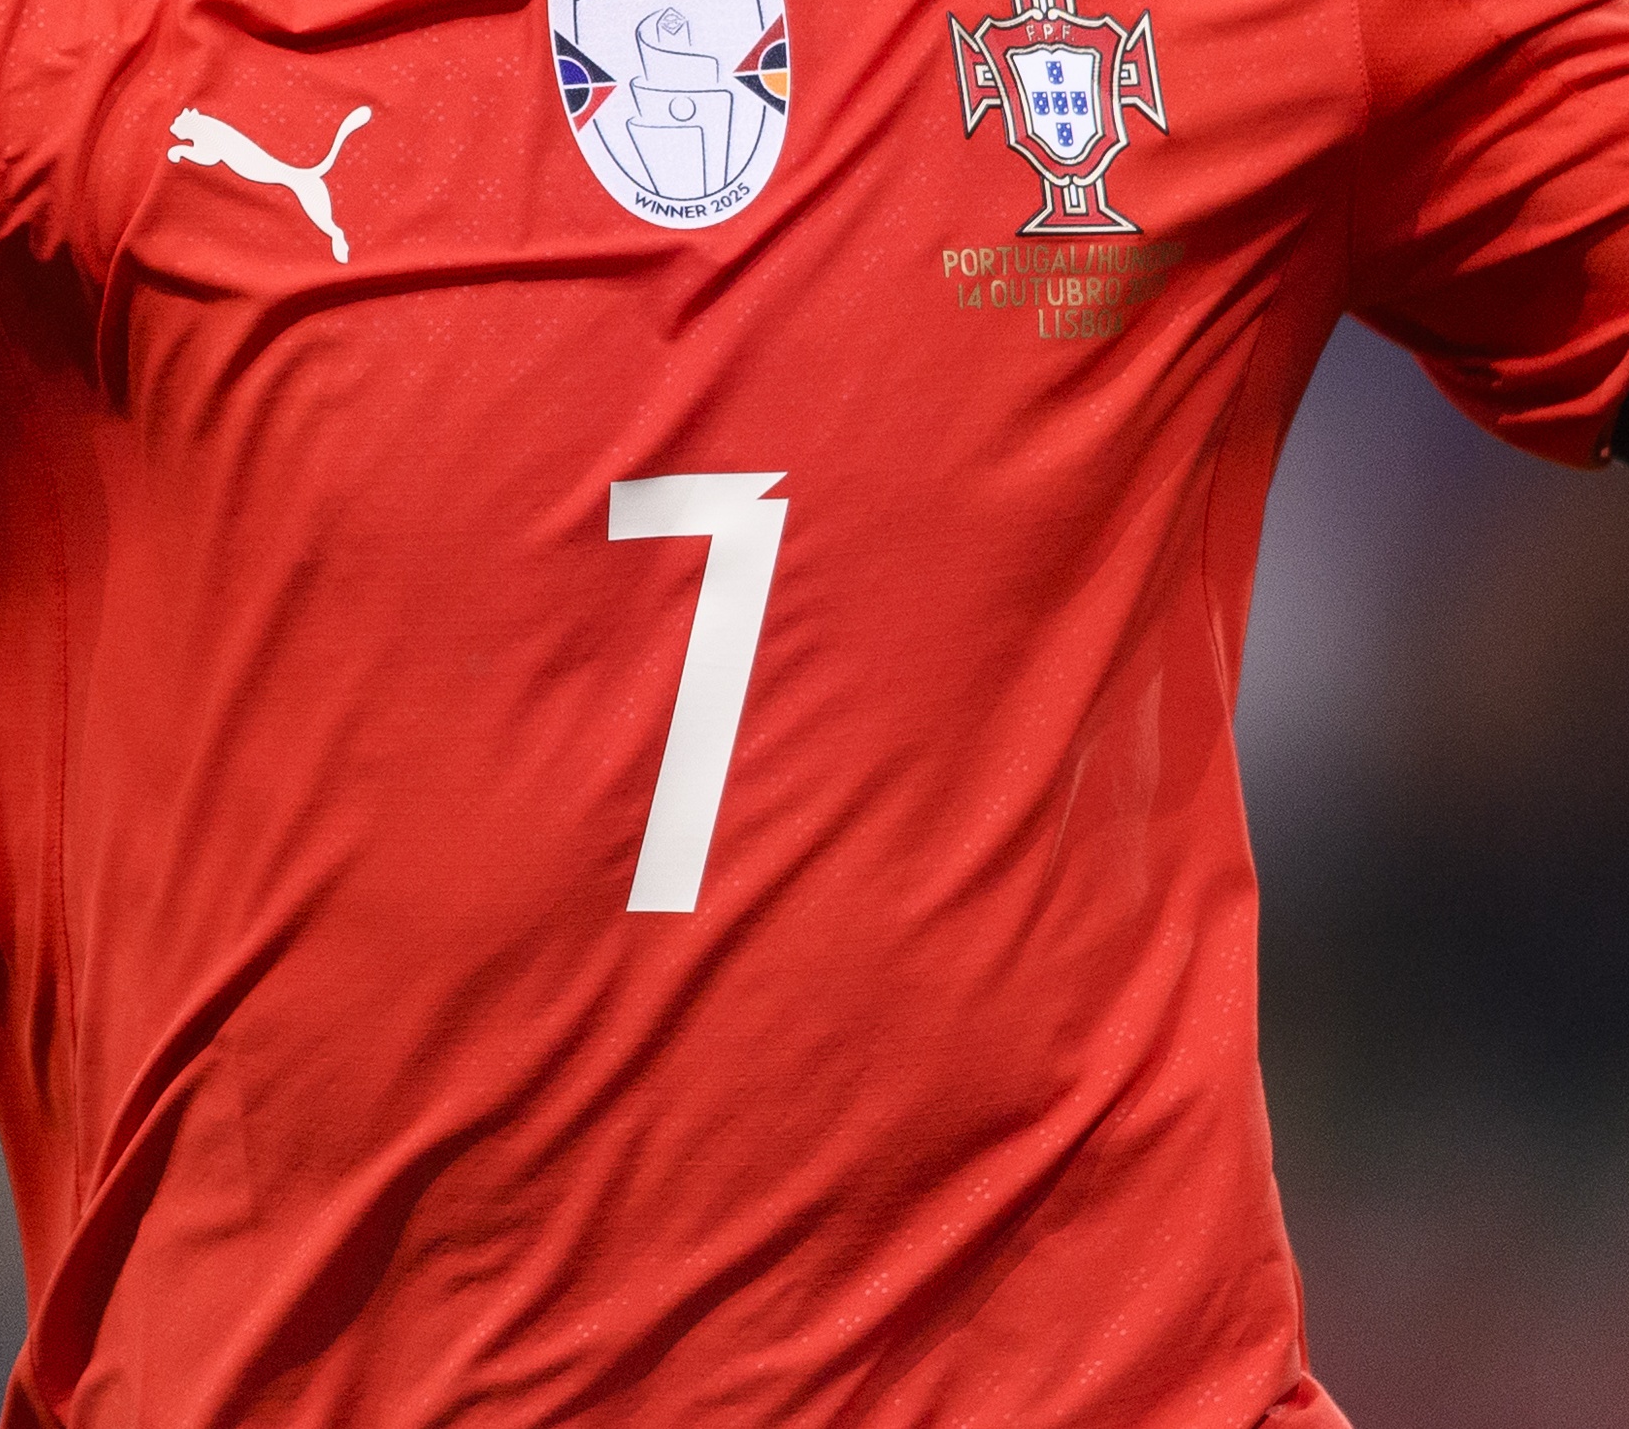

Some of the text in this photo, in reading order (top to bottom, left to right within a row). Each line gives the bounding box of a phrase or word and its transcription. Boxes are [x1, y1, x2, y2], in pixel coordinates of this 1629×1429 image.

[634, 182, 751, 219] WINNER 2025
[957, 282, 983, 309] 14
[990, 276, 1121, 308] OUTUBRO
[608, 471, 789, 913] 7
